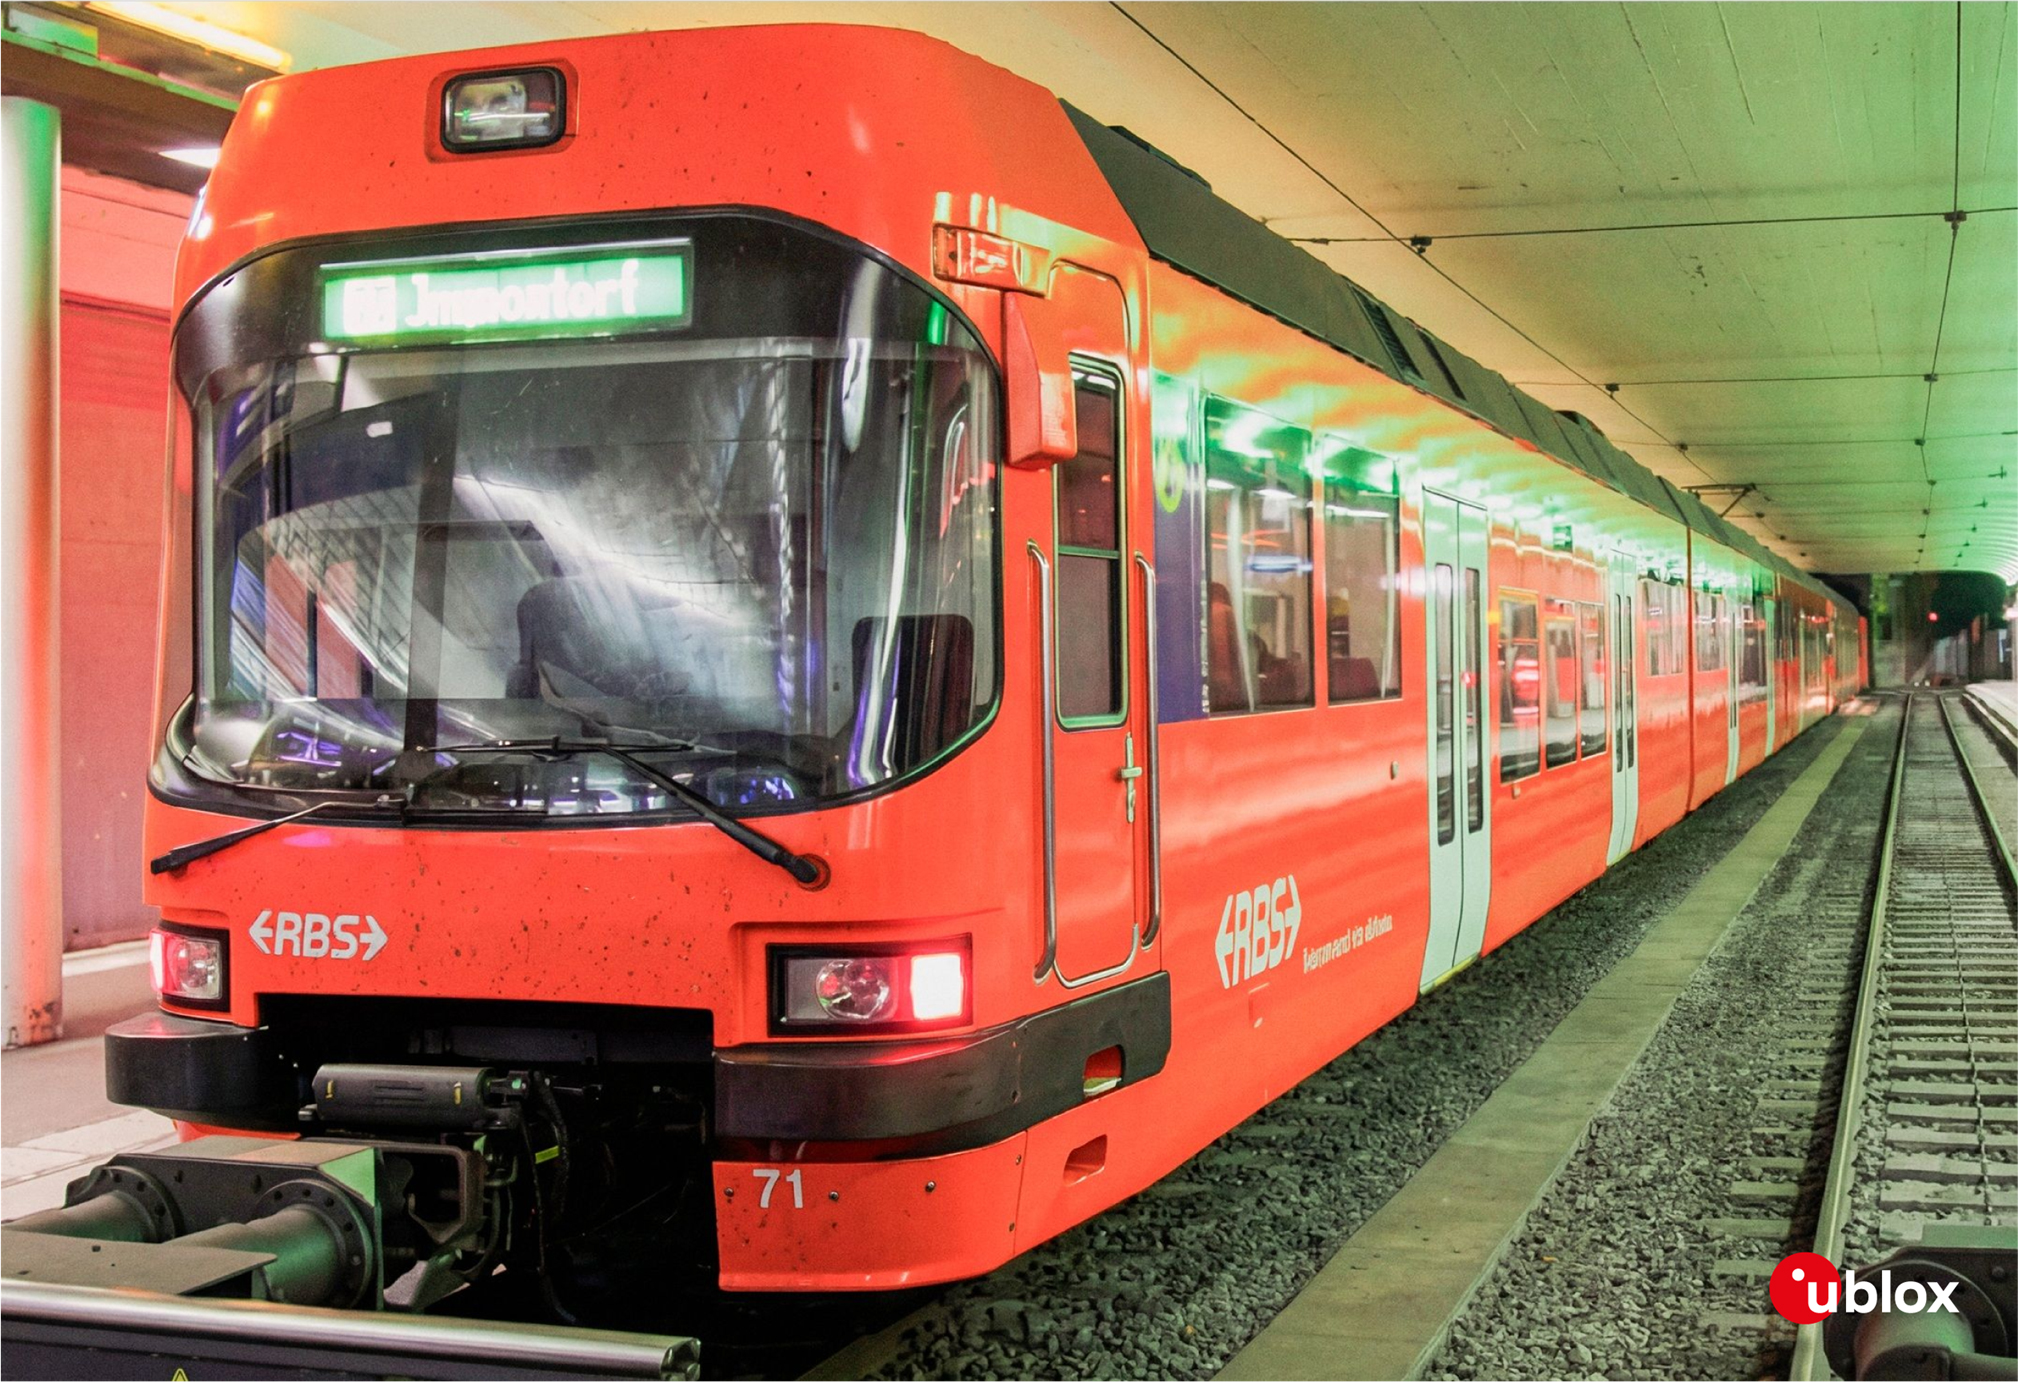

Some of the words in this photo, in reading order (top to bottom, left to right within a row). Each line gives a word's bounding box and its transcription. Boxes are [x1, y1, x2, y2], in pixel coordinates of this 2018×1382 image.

[273, 910, 360, 960] RBS
[1231, 876, 1287, 987] RBS
[752, 1168, 804, 1209] 71
